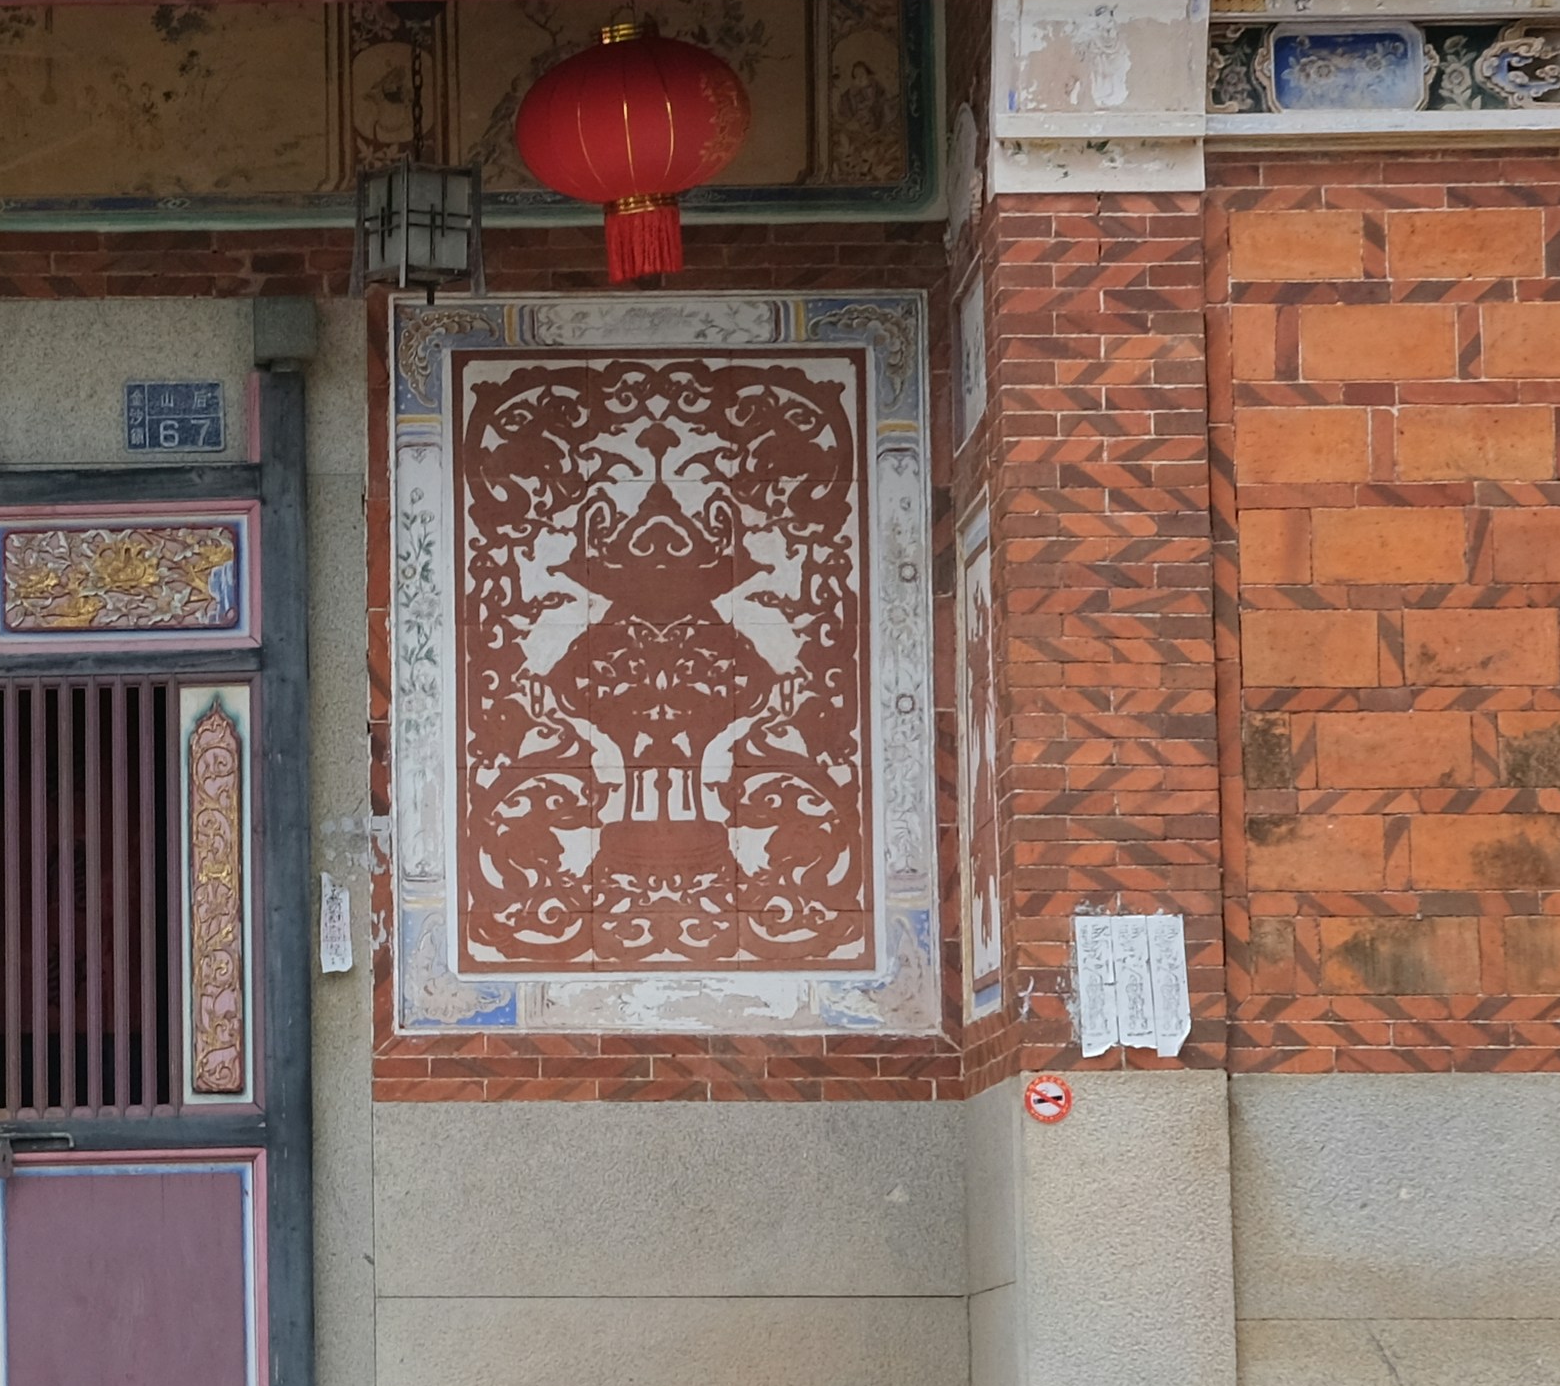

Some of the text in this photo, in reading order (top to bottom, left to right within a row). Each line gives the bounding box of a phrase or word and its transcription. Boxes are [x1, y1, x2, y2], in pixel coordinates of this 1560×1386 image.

[130, 390, 144, 445] 金沙鎮
[160, 419, 211, 447] 67
